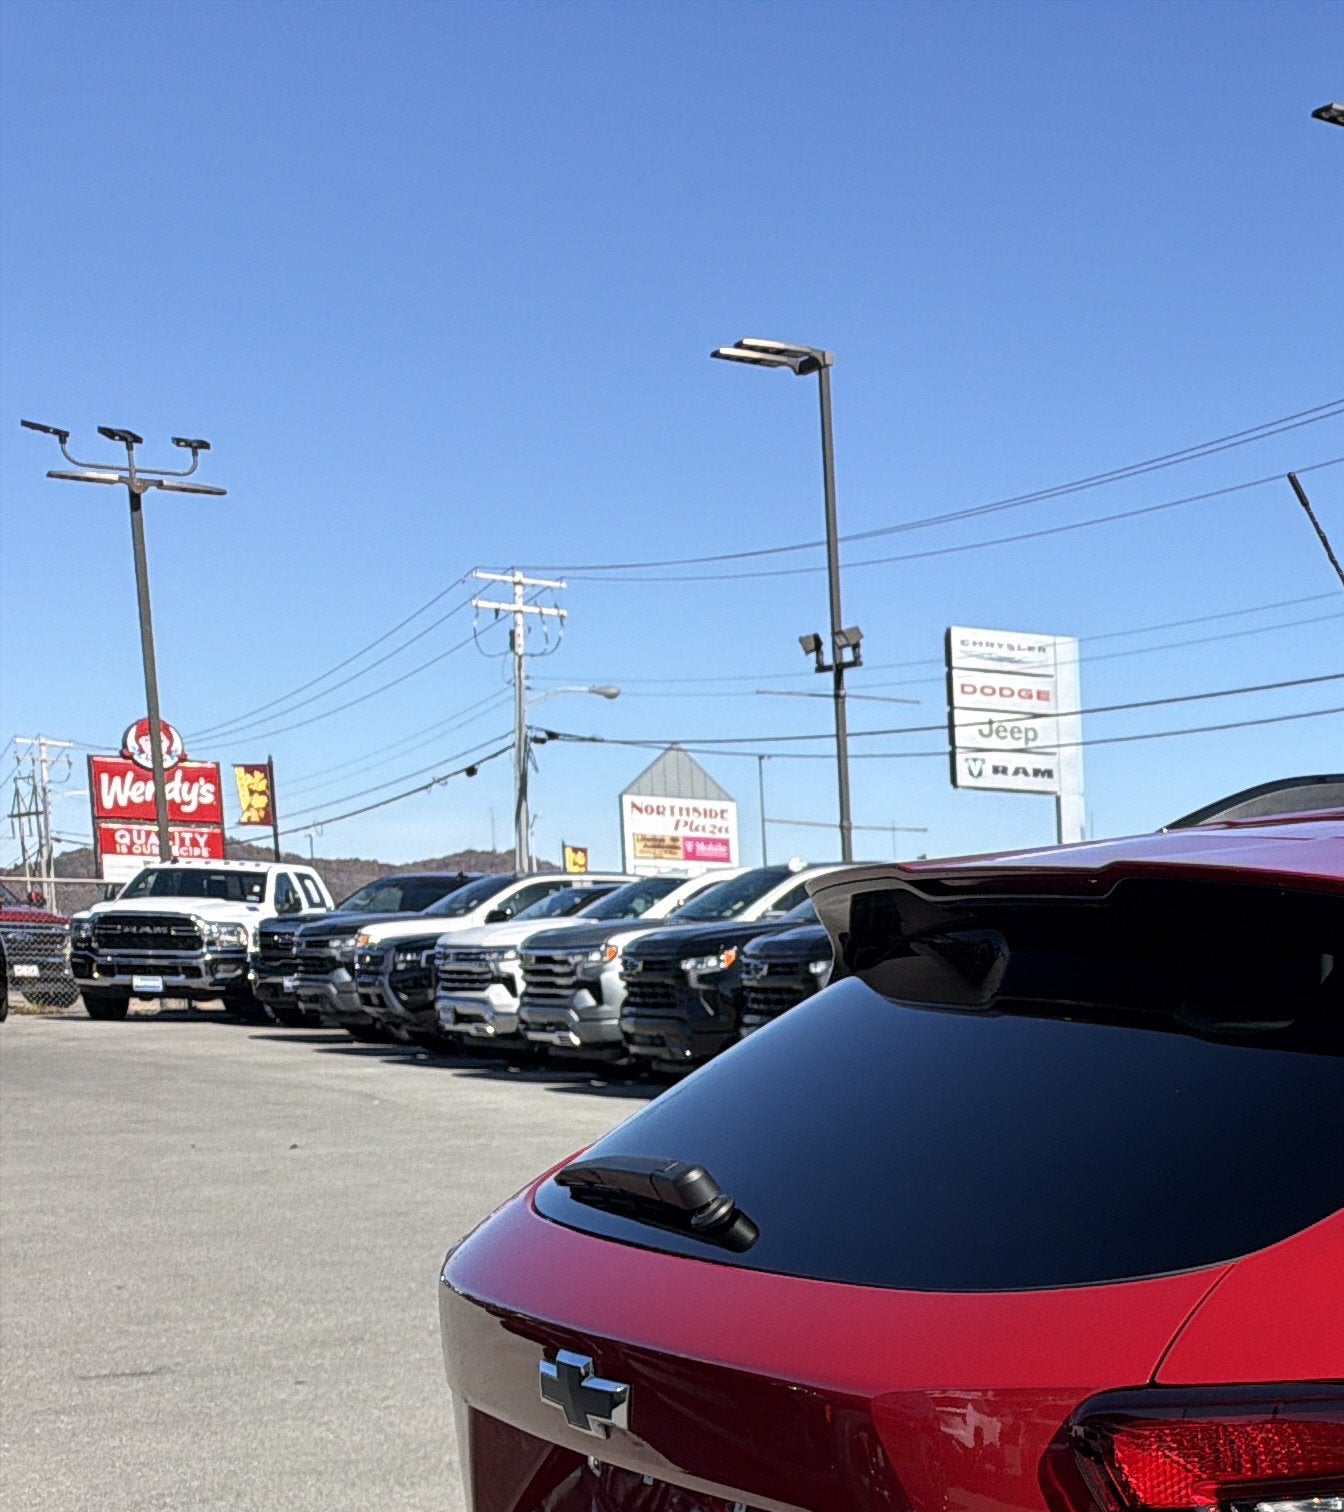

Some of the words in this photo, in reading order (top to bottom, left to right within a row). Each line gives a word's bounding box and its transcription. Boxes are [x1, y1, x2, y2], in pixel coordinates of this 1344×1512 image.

[960, 683, 1051, 701] DODGE
[978, 718, 1038, 745] Jeep
[992, 764, 1054, 779] RAM
[100, 769, 215, 813] Wendy's
[630, 800, 729, 821] NORTHSIDE
[673, 818, 730, 835] Plaza
[115, 829, 208, 847] QUAITY
[170, 845, 211, 857] ECIPE
